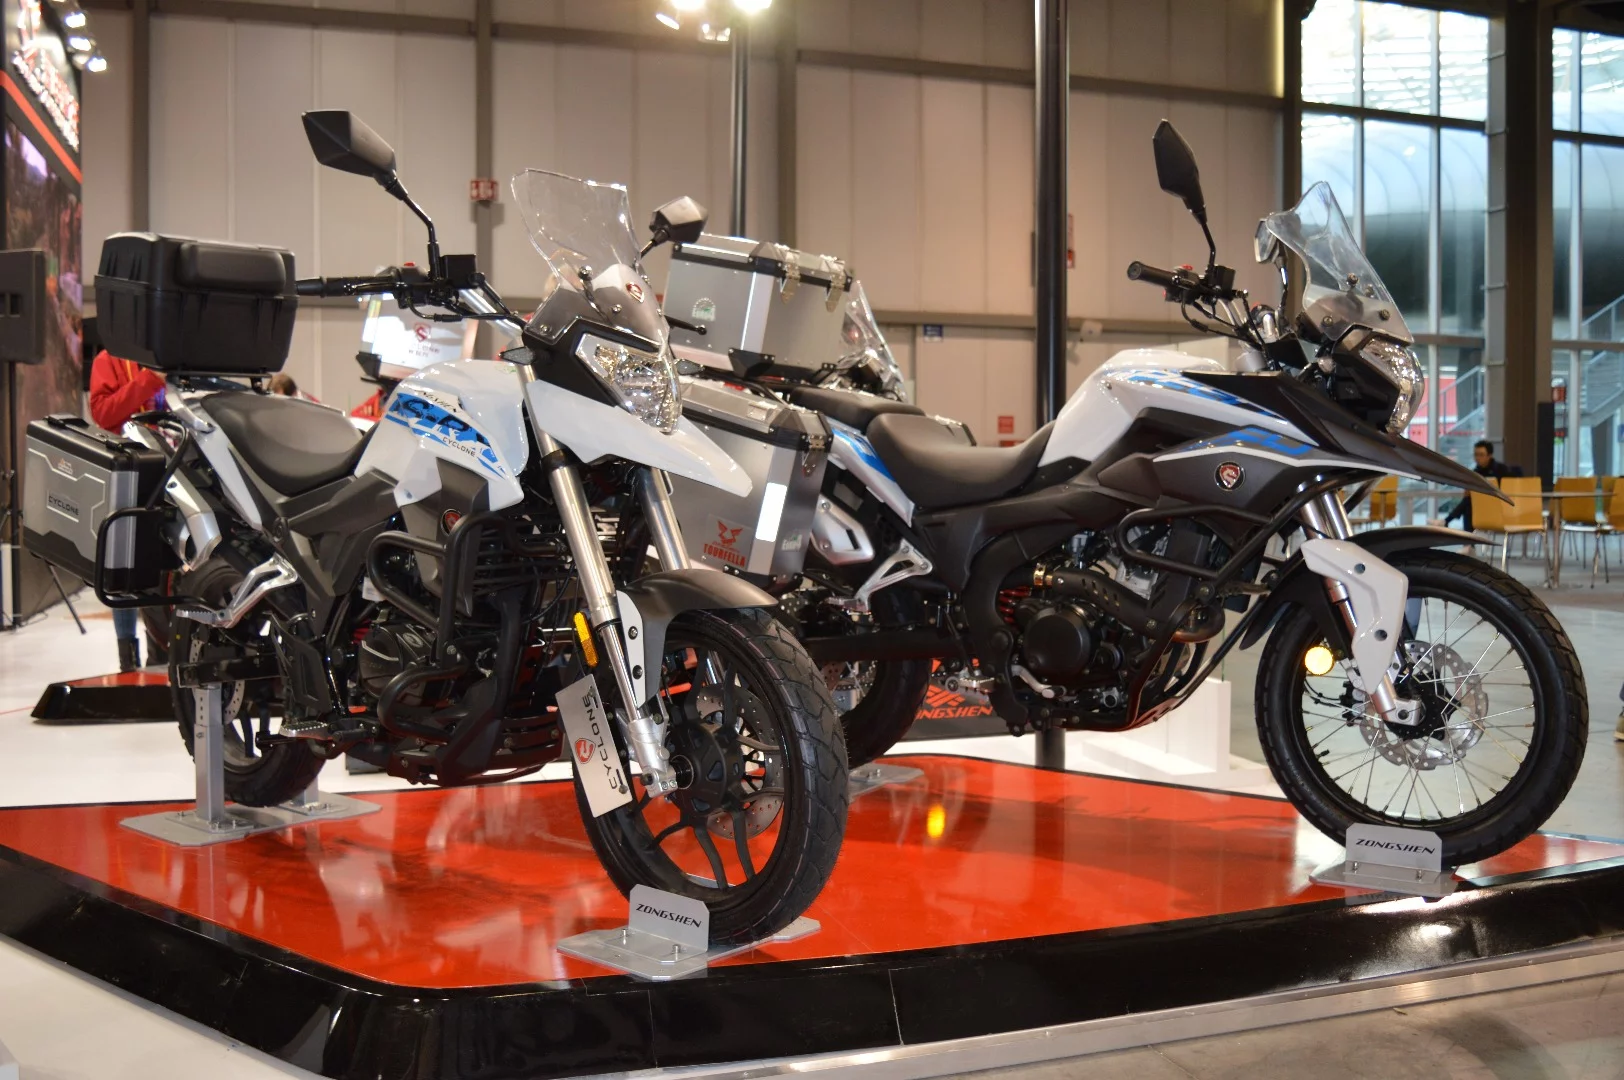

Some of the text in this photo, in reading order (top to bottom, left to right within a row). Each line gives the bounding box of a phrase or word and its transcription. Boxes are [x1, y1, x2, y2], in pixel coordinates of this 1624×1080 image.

[442, 436, 477, 457] CYCLONE
[48, 495, 80, 516] CYCLONE
[703, 543, 747, 568] TOURFELLA
[914, 705, 994, 720] NGSHEN
[582, 695, 618, 790] CYCLONE
[1355, 838, 1436, 855] ZONGSHEN
[635, 903, 702, 928] ZONGSHEN
